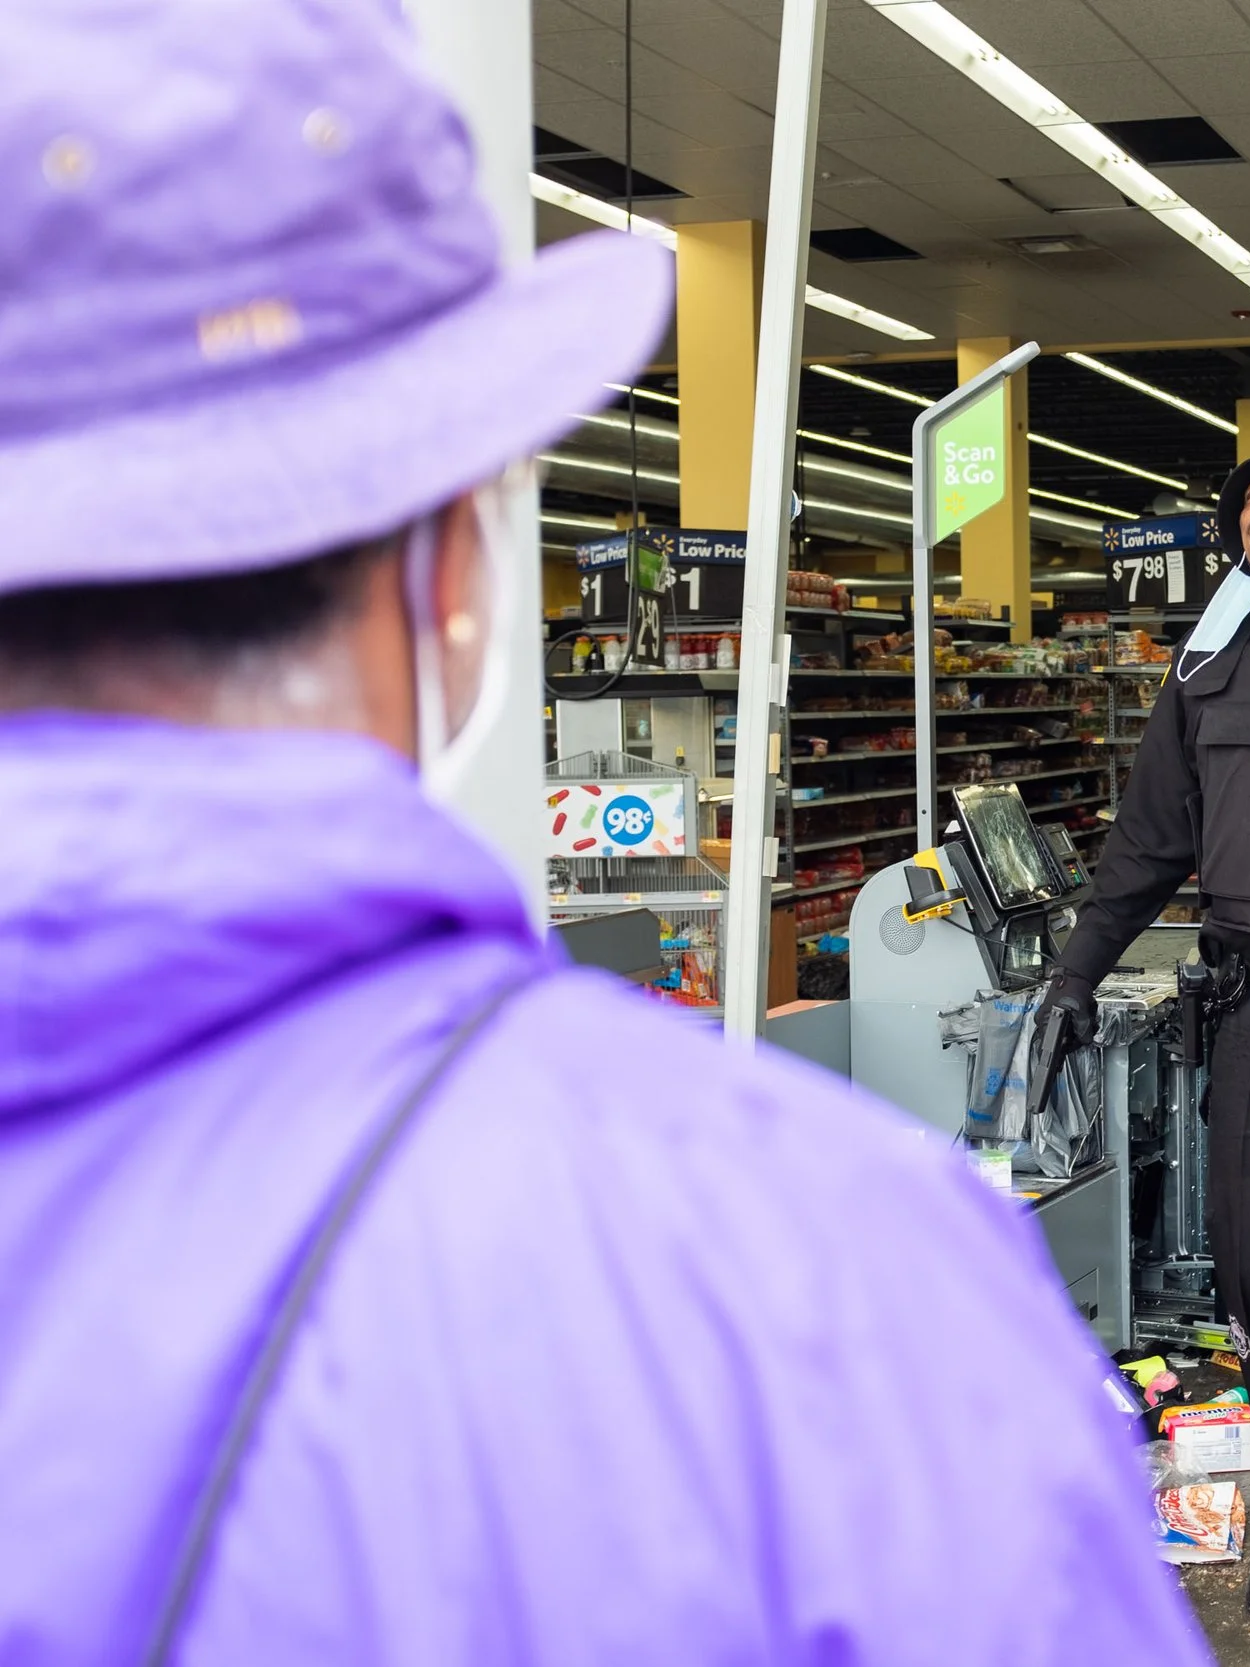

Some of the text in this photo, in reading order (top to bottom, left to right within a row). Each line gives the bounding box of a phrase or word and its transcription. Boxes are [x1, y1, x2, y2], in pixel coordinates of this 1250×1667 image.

[944, 441, 995, 462] Scan
[944, 463, 995, 485] & Go
[679, 536, 708, 544] Everyday
[1122, 529, 1175, 548] Low Price
[590, 549, 608, 565] Low
[678, 543, 712, 557] Low
[606, 807, 652, 836] 98¢
[1181, 1407, 1242, 1418] mentos
